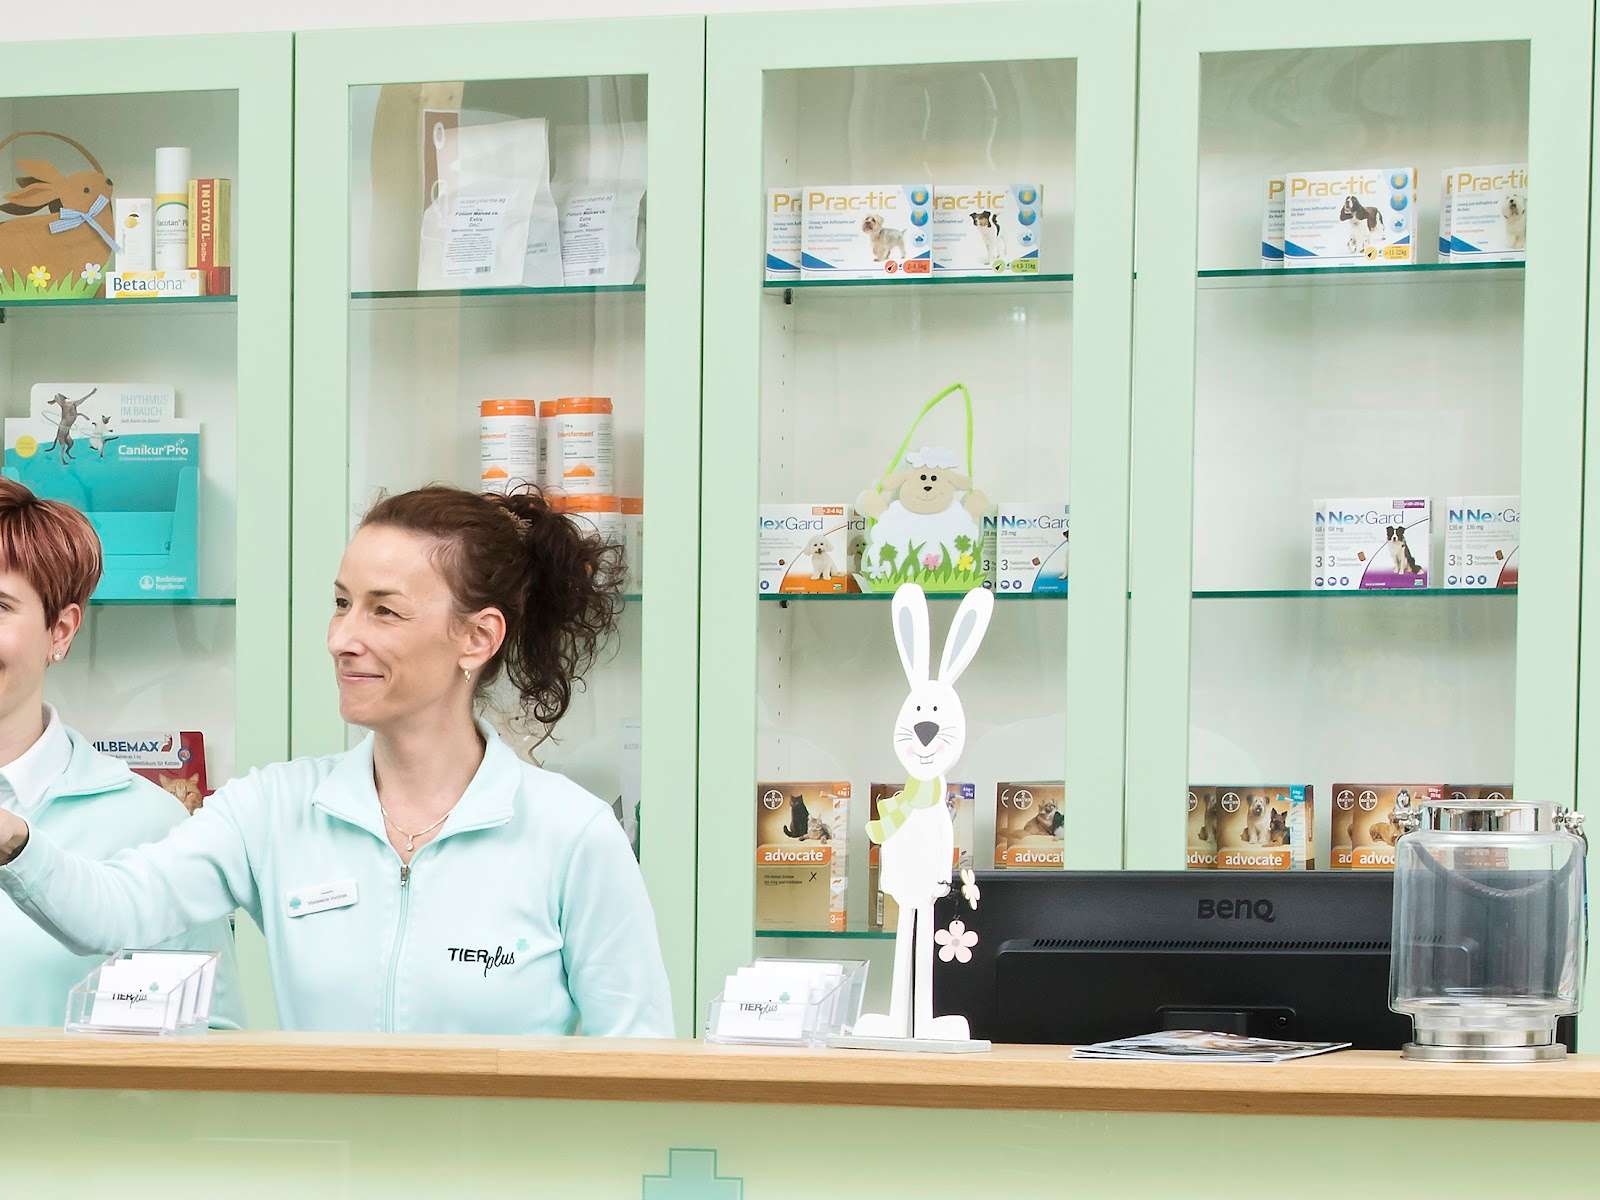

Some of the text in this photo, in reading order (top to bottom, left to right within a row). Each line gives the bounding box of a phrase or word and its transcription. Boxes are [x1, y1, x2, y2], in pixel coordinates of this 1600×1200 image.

[1291, 176, 1377, 197] Prac-tic
[808, 191, 897, 211] Prac-tic
[933, 191, 1005, 210] rac-tic
[113, 277, 183, 292] Betadona
[1328, 510, 1405, 525] NexGard
[93, 741, 159, 752] ILBEMAX
[764, 848, 824, 862] advocate
[1225, 851, 1283, 866] advocate
[1197, 899, 1275, 923] BenQ
